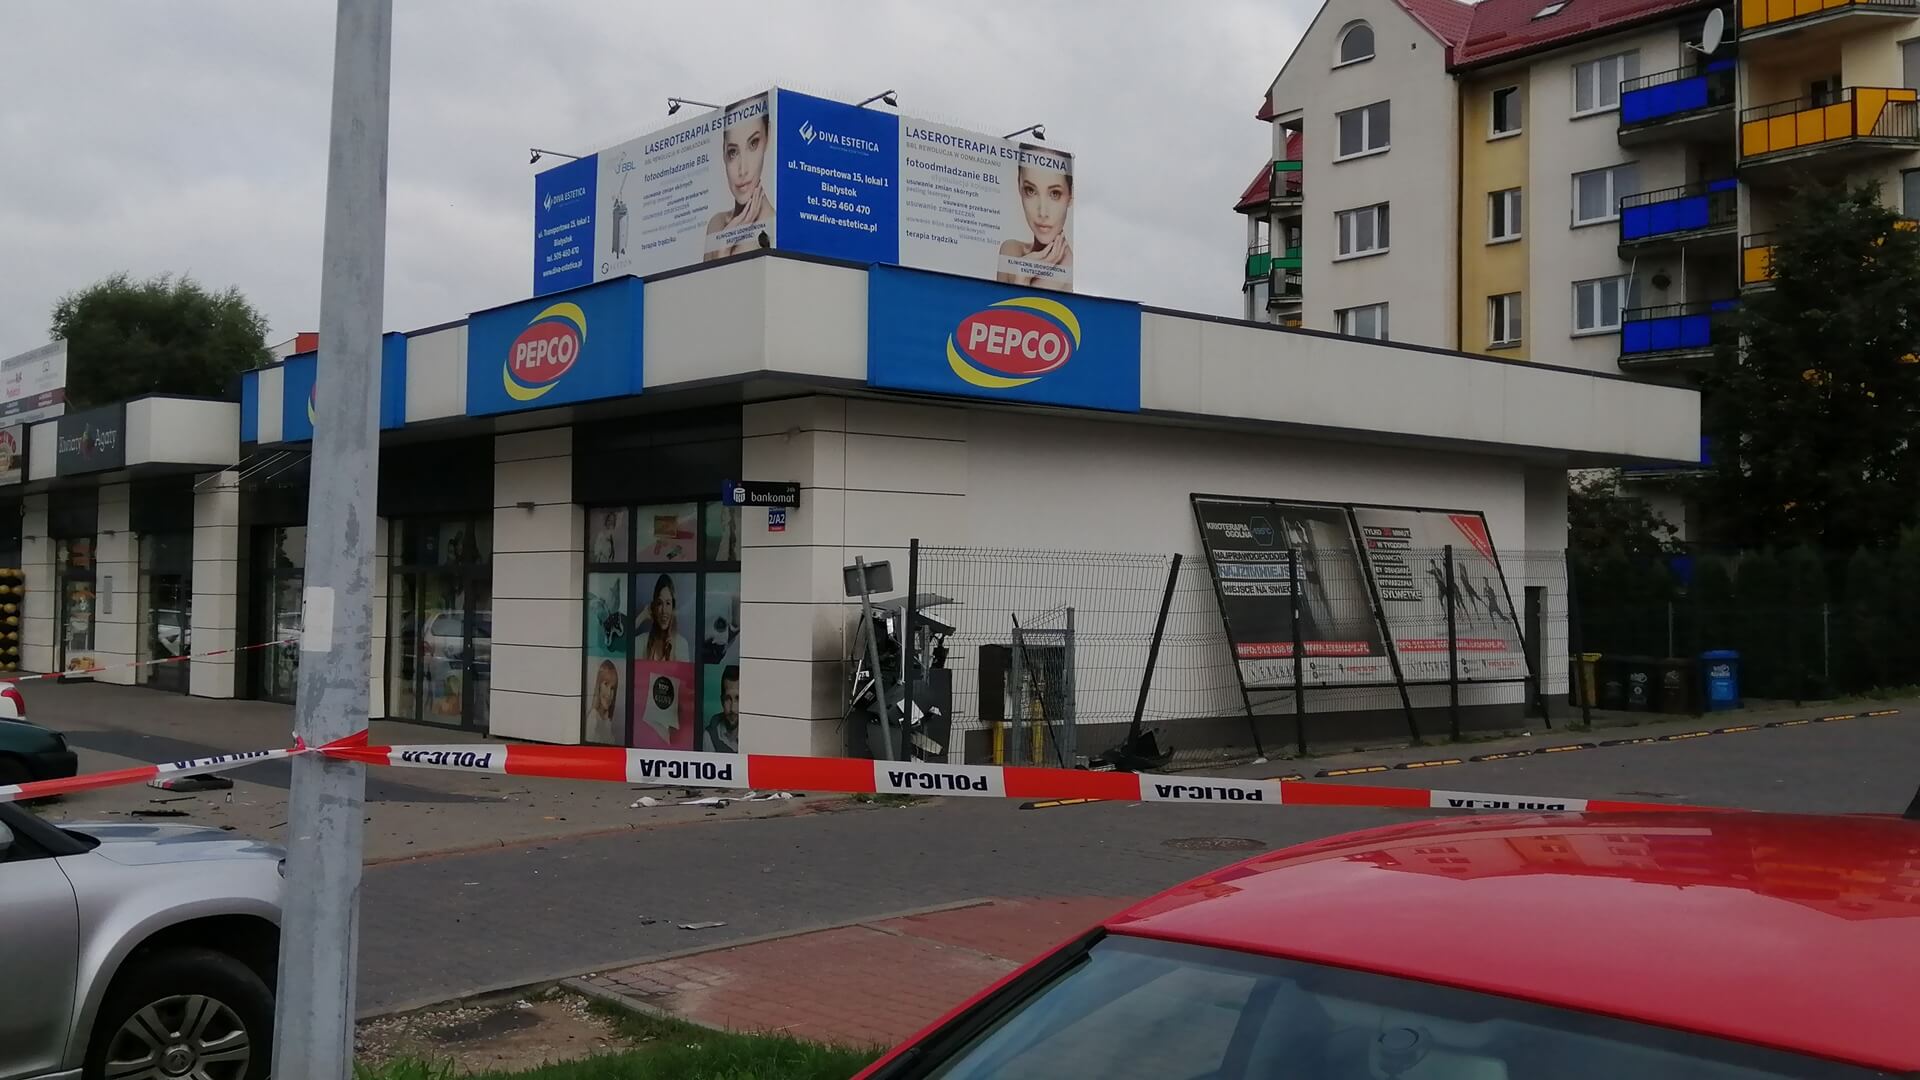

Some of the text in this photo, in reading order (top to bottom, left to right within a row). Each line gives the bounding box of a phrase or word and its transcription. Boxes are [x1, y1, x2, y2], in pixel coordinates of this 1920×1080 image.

[645, 123, 709, 155] LASEROTERAPIA
[711, 100, 768, 131] ESTETYCZNA
[819, 131, 839, 144] DIVA
[841, 136, 879, 152] ESTETICA
[906, 127, 1067, 170] LASEROTERAPIA ESTETYCZNA
[645, 160, 695, 182] fotoodmładzanie
[697, 153, 709, 166] BBL
[788, 160, 798, 169] ul.
[800, 161, 851, 180] Transportowa
[865, 175, 883, 186] lokal
[906, 157, 1000, 185] fotoodmładzanie BBL
[565, 187, 585, 200] ESTETICA
[821, 182, 857, 197] Białystok
[807, 195, 871, 215] tel. 505 460 470
[800, 211, 877, 233] www.diva-estetica.pl
[906, 229, 958, 245] terapia trądziku
[516, 334, 573, 369] PEPCO
[969, 322, 1061, 361] PEPCO
[751, 491, 795, 503] bankomat
[769, 513, 785, 524] 2/A2
[401, 750, 492, 769] POLICJA
[640, 759, 732, 781] POLICJA
[888, 771, 988, 791] POLICJA
[1154, 784, 1263, 801] POLICJA
